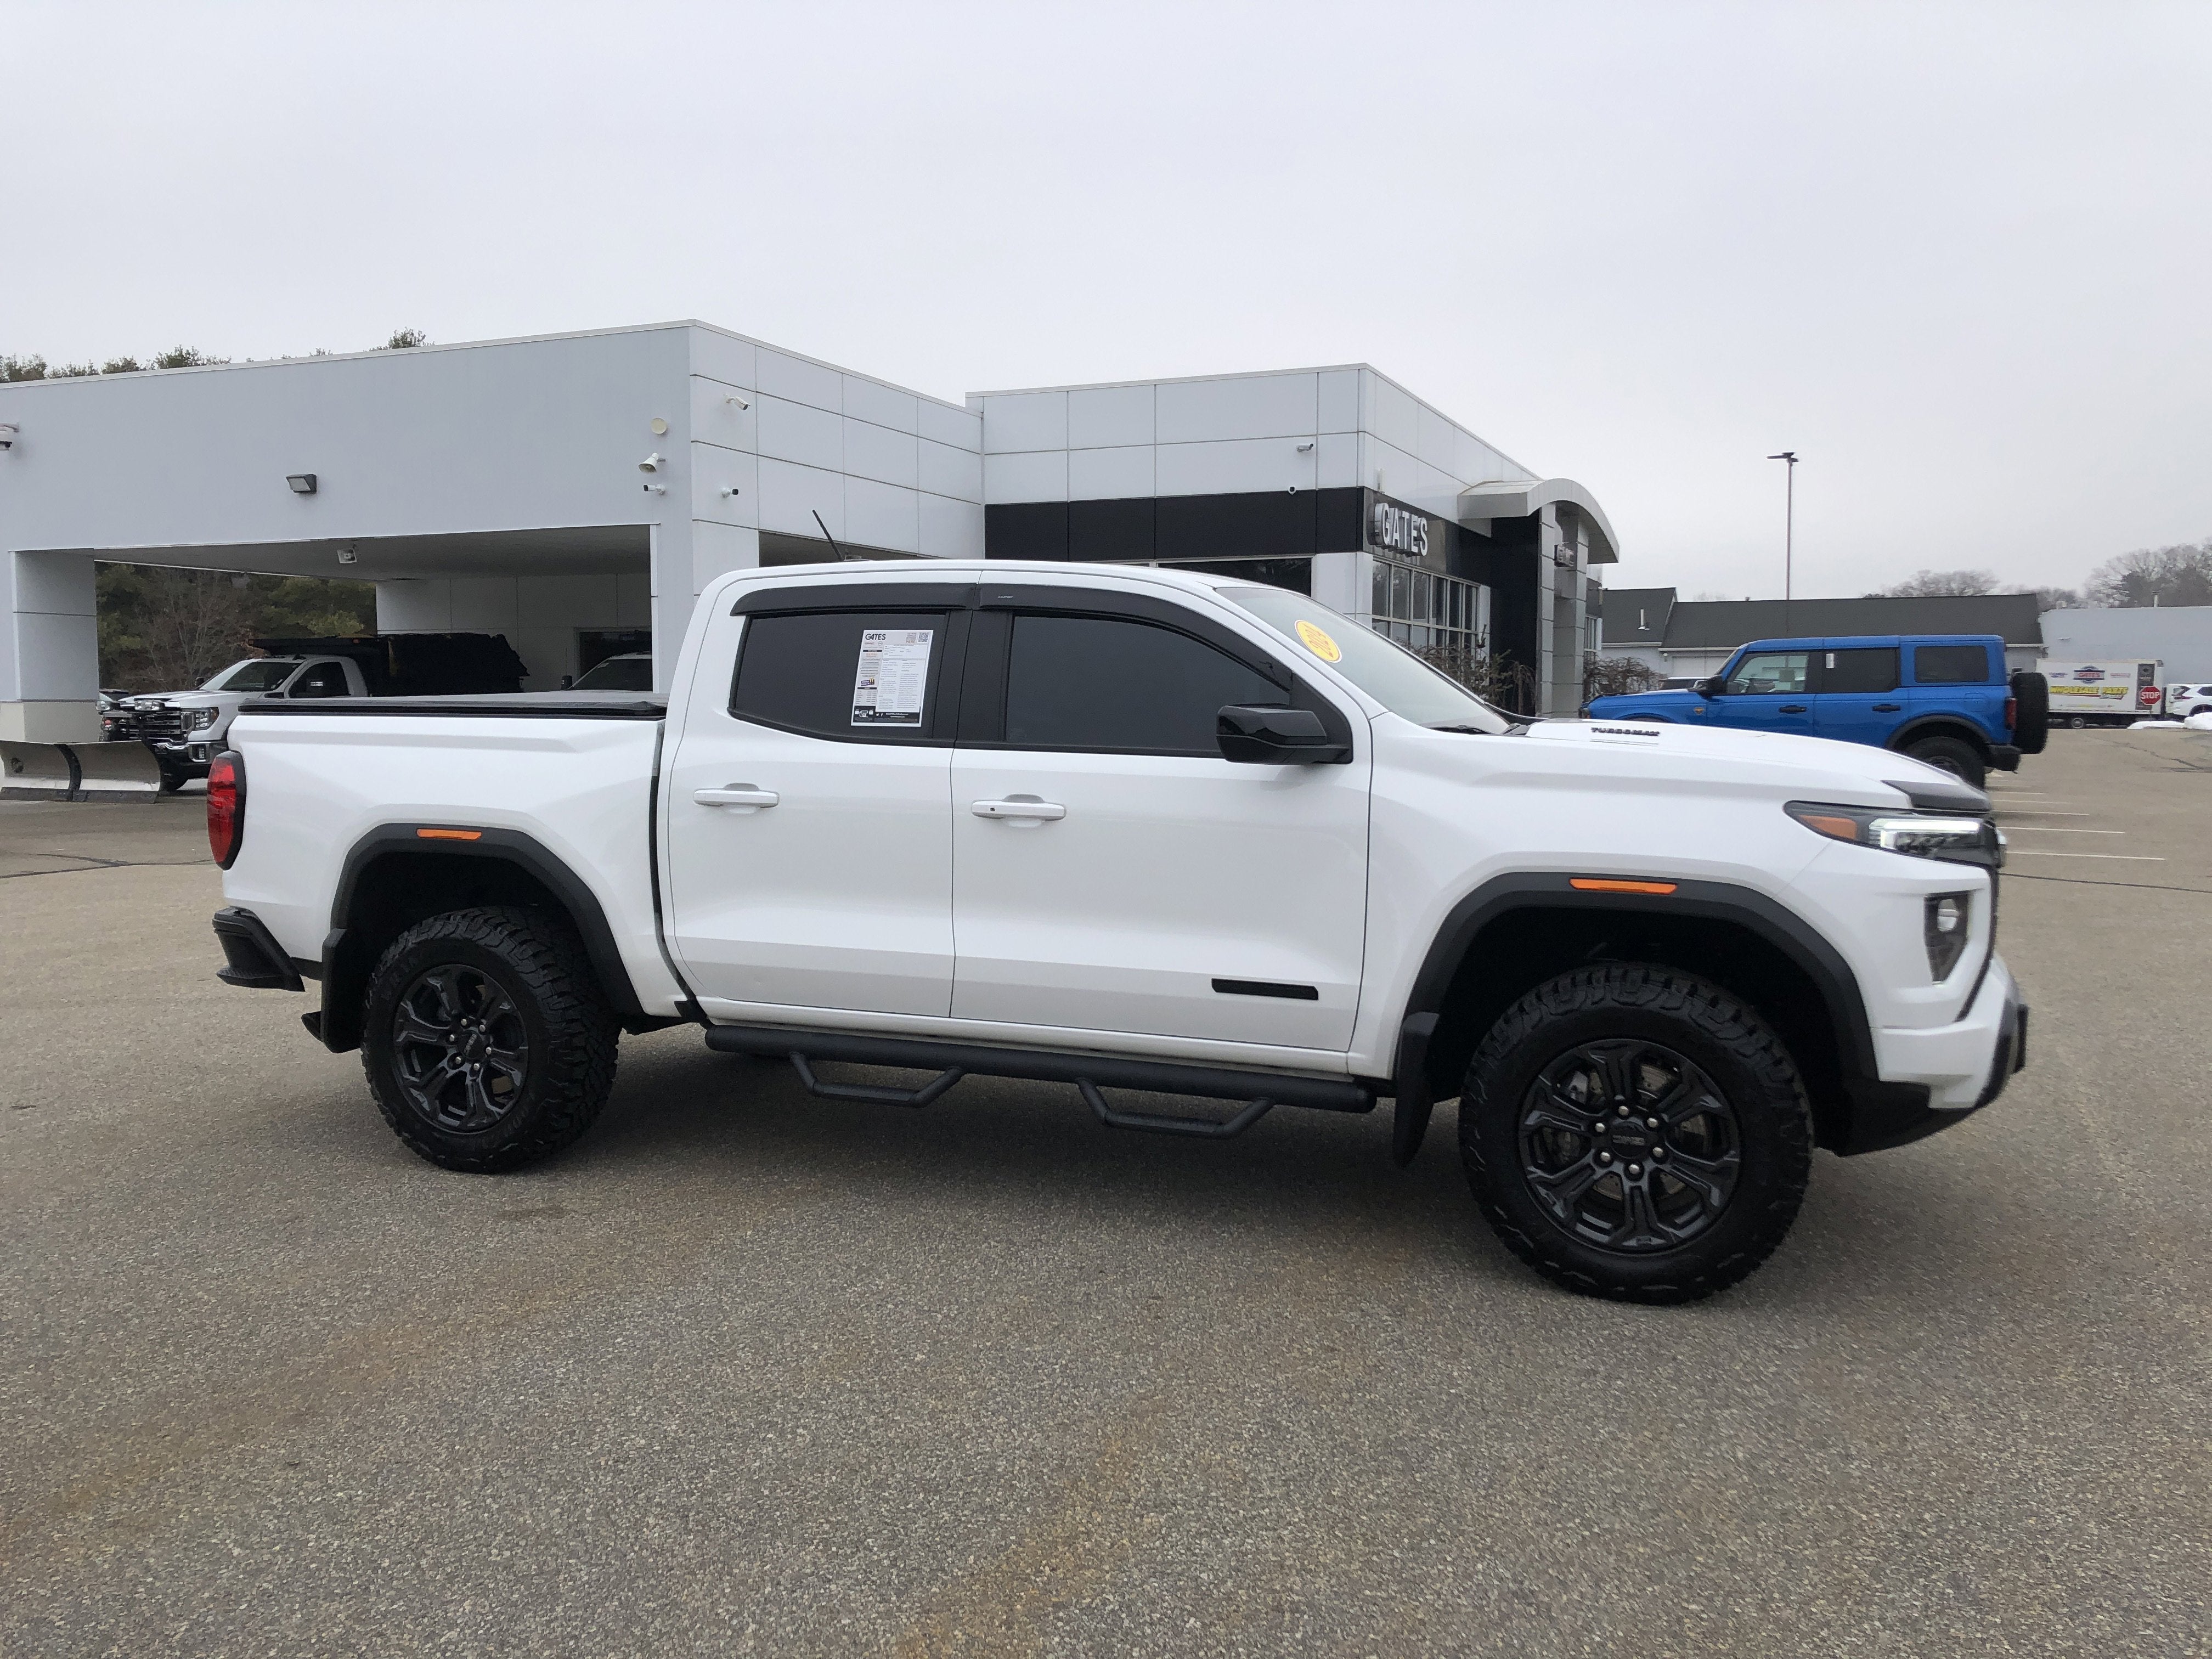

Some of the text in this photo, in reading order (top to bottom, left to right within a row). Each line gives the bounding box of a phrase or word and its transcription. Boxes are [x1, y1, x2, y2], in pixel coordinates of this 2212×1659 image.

[1375, 503, 1428, 556] GATES
[1303, 623, 1334, 658] 2024
[2050, 686, 2129, 695] WHOLESALE PARTS
[1591, 727, 1661, 736] TURBOMAX
